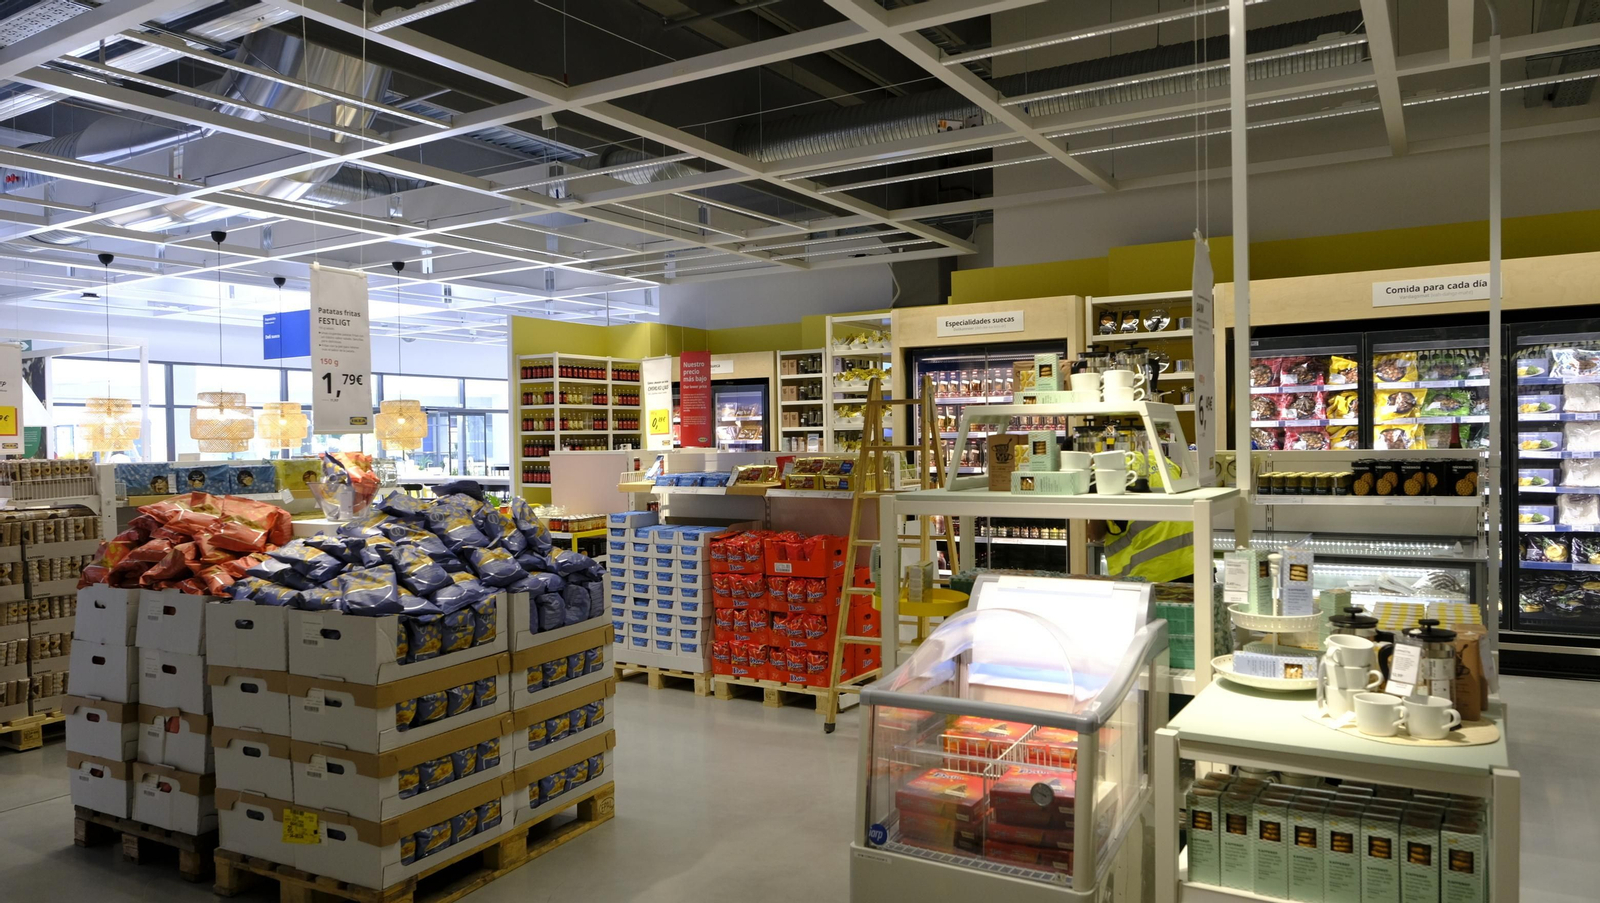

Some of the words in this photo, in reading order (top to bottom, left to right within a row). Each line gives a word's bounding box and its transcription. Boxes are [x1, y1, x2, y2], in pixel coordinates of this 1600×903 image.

[1386, 286, 1420, 294] Comida
[1423, 284, 1445, 293] para
[1447, 281, 1470, 290] cada
[1472, 280, 1488, 288] día
[318, 306, 343, 316] Patatas
[344, 310, 361, 318] fritas
[318, 316, 351, 326] FESTLIGT
[945, 318, 991, 328] Especialidades
[334, 360, 339, 368] g
